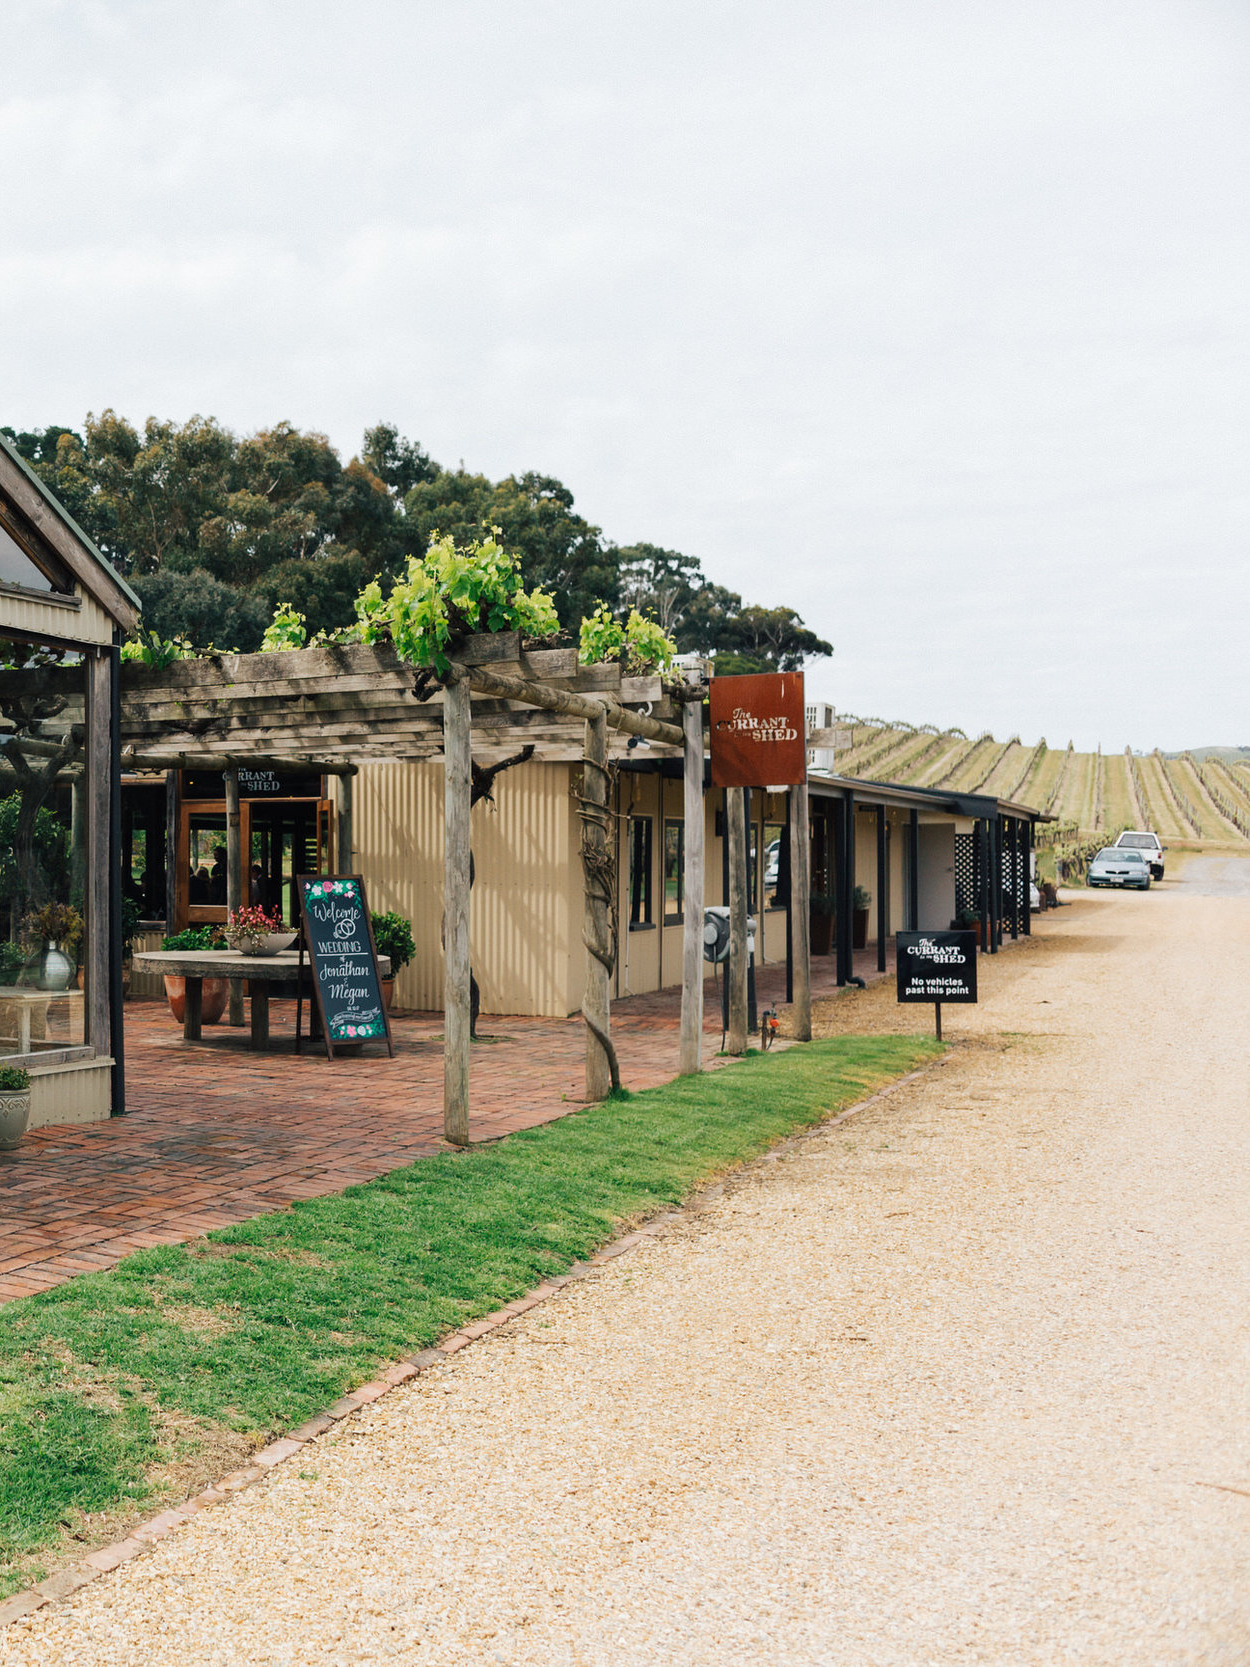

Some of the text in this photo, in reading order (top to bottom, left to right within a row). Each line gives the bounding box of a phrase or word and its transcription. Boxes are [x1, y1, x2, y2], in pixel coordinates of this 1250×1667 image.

[733, 707, 751, 719] The
[716, 717, 789, 732] CURRANT
[752, 728, 798, 742] SHED
[222, 771, 275, 782] CRRANT
[247, 781, 280, 791] SHED
[313, 901, 361, 923] Welcome
[317, 941, 362, 953] WEDDING
[918, 938, 935, 947] The
[907, 946, 960, 955] CURRANT
[933, 954, 966, 963] SHED
[319, 960, 370, 981] Jonathan
[911, 977, 963, 986] No vehicles
[327, 984, 370, 1006] Megan
[905, 986, 969, 996] past this point
